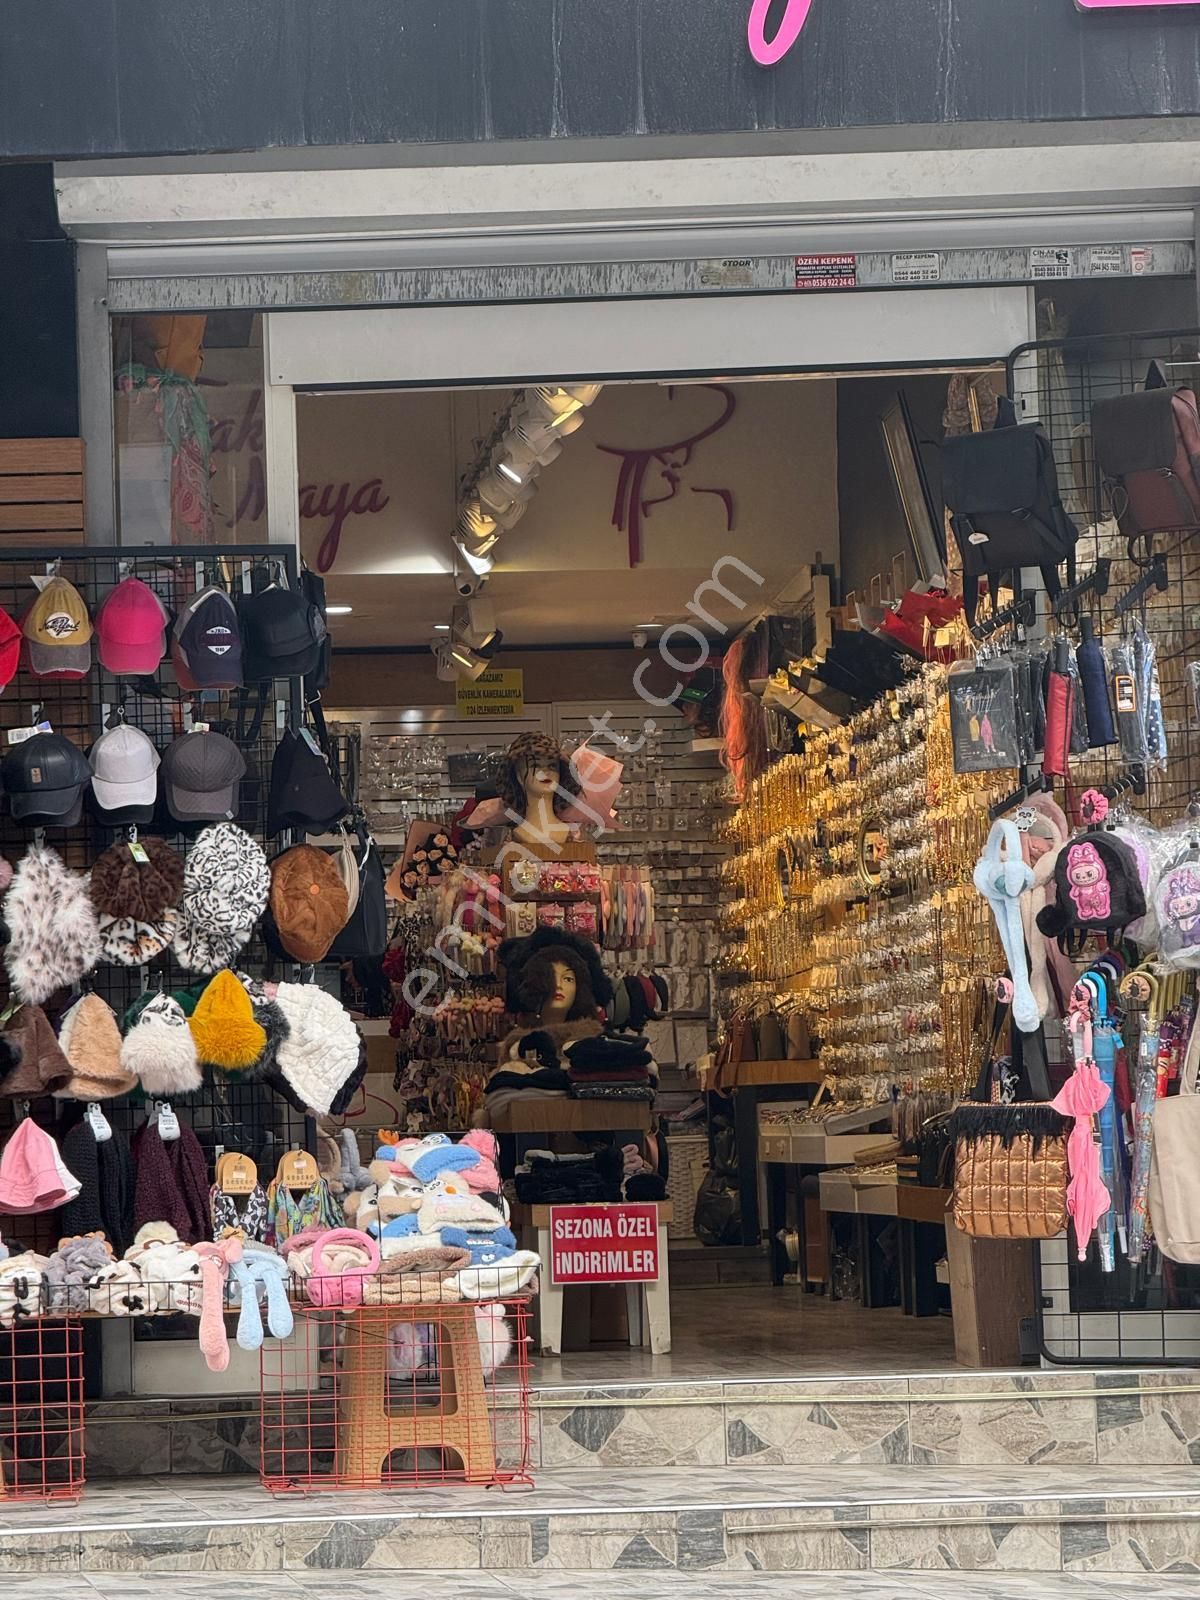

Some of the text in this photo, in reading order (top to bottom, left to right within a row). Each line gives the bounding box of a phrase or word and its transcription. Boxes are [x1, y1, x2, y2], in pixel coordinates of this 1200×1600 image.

[797, 256, 853, 266] ÖZEN KEPENK
[812, 277, 855, 287] 0536 922 24 43
[555, 1213, 655, 1240] SEZONA ÖZEL
